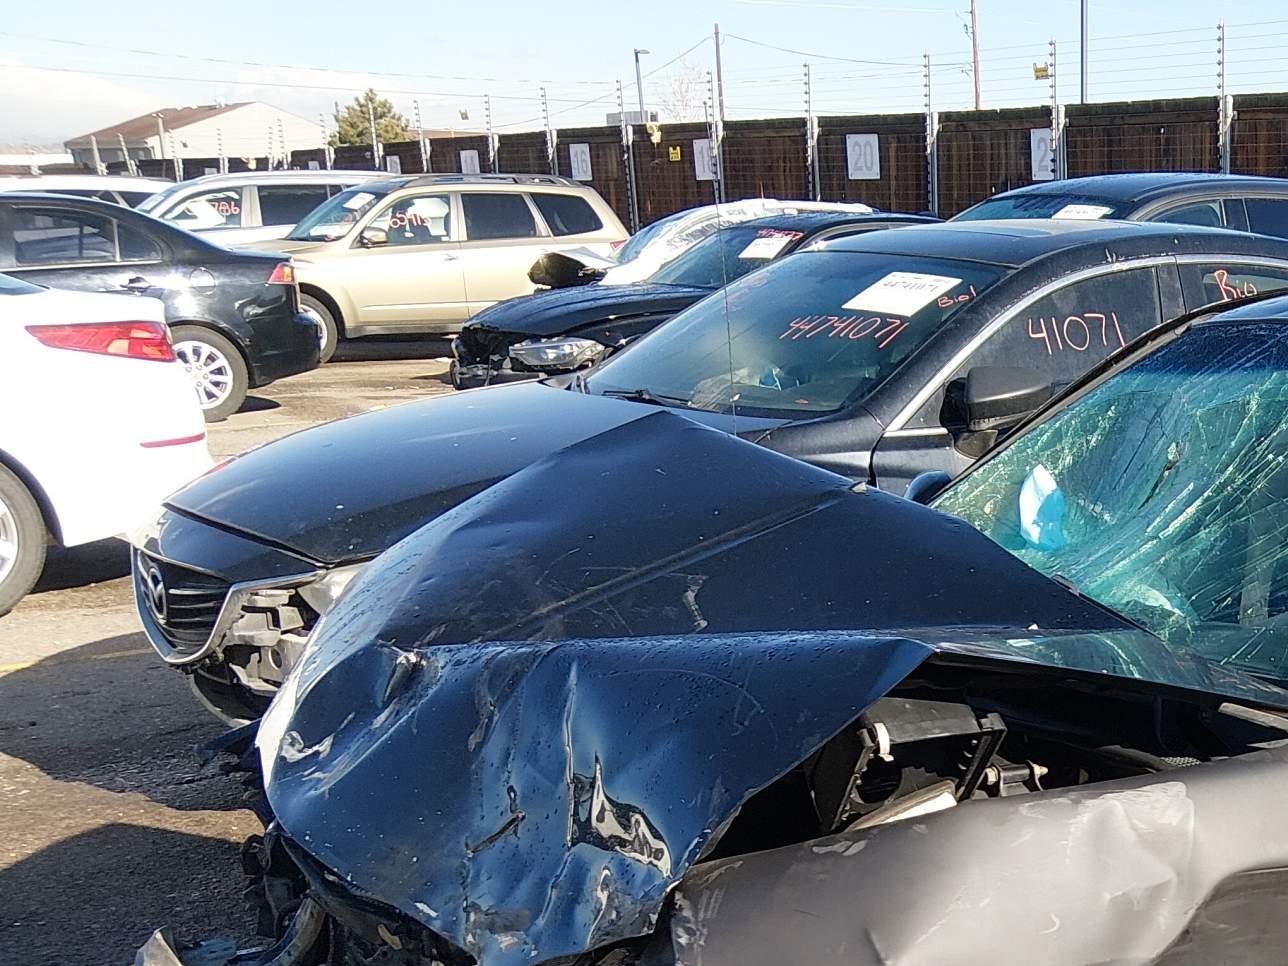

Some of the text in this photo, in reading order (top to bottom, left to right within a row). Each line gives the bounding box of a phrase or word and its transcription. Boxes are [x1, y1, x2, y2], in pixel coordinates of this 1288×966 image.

[574, 150, 588, 174] 16
[851, 140, 874, 172] 20
[779, 315, 910, 349] 44741071
[1028, 311, 1126, 355] 41071
